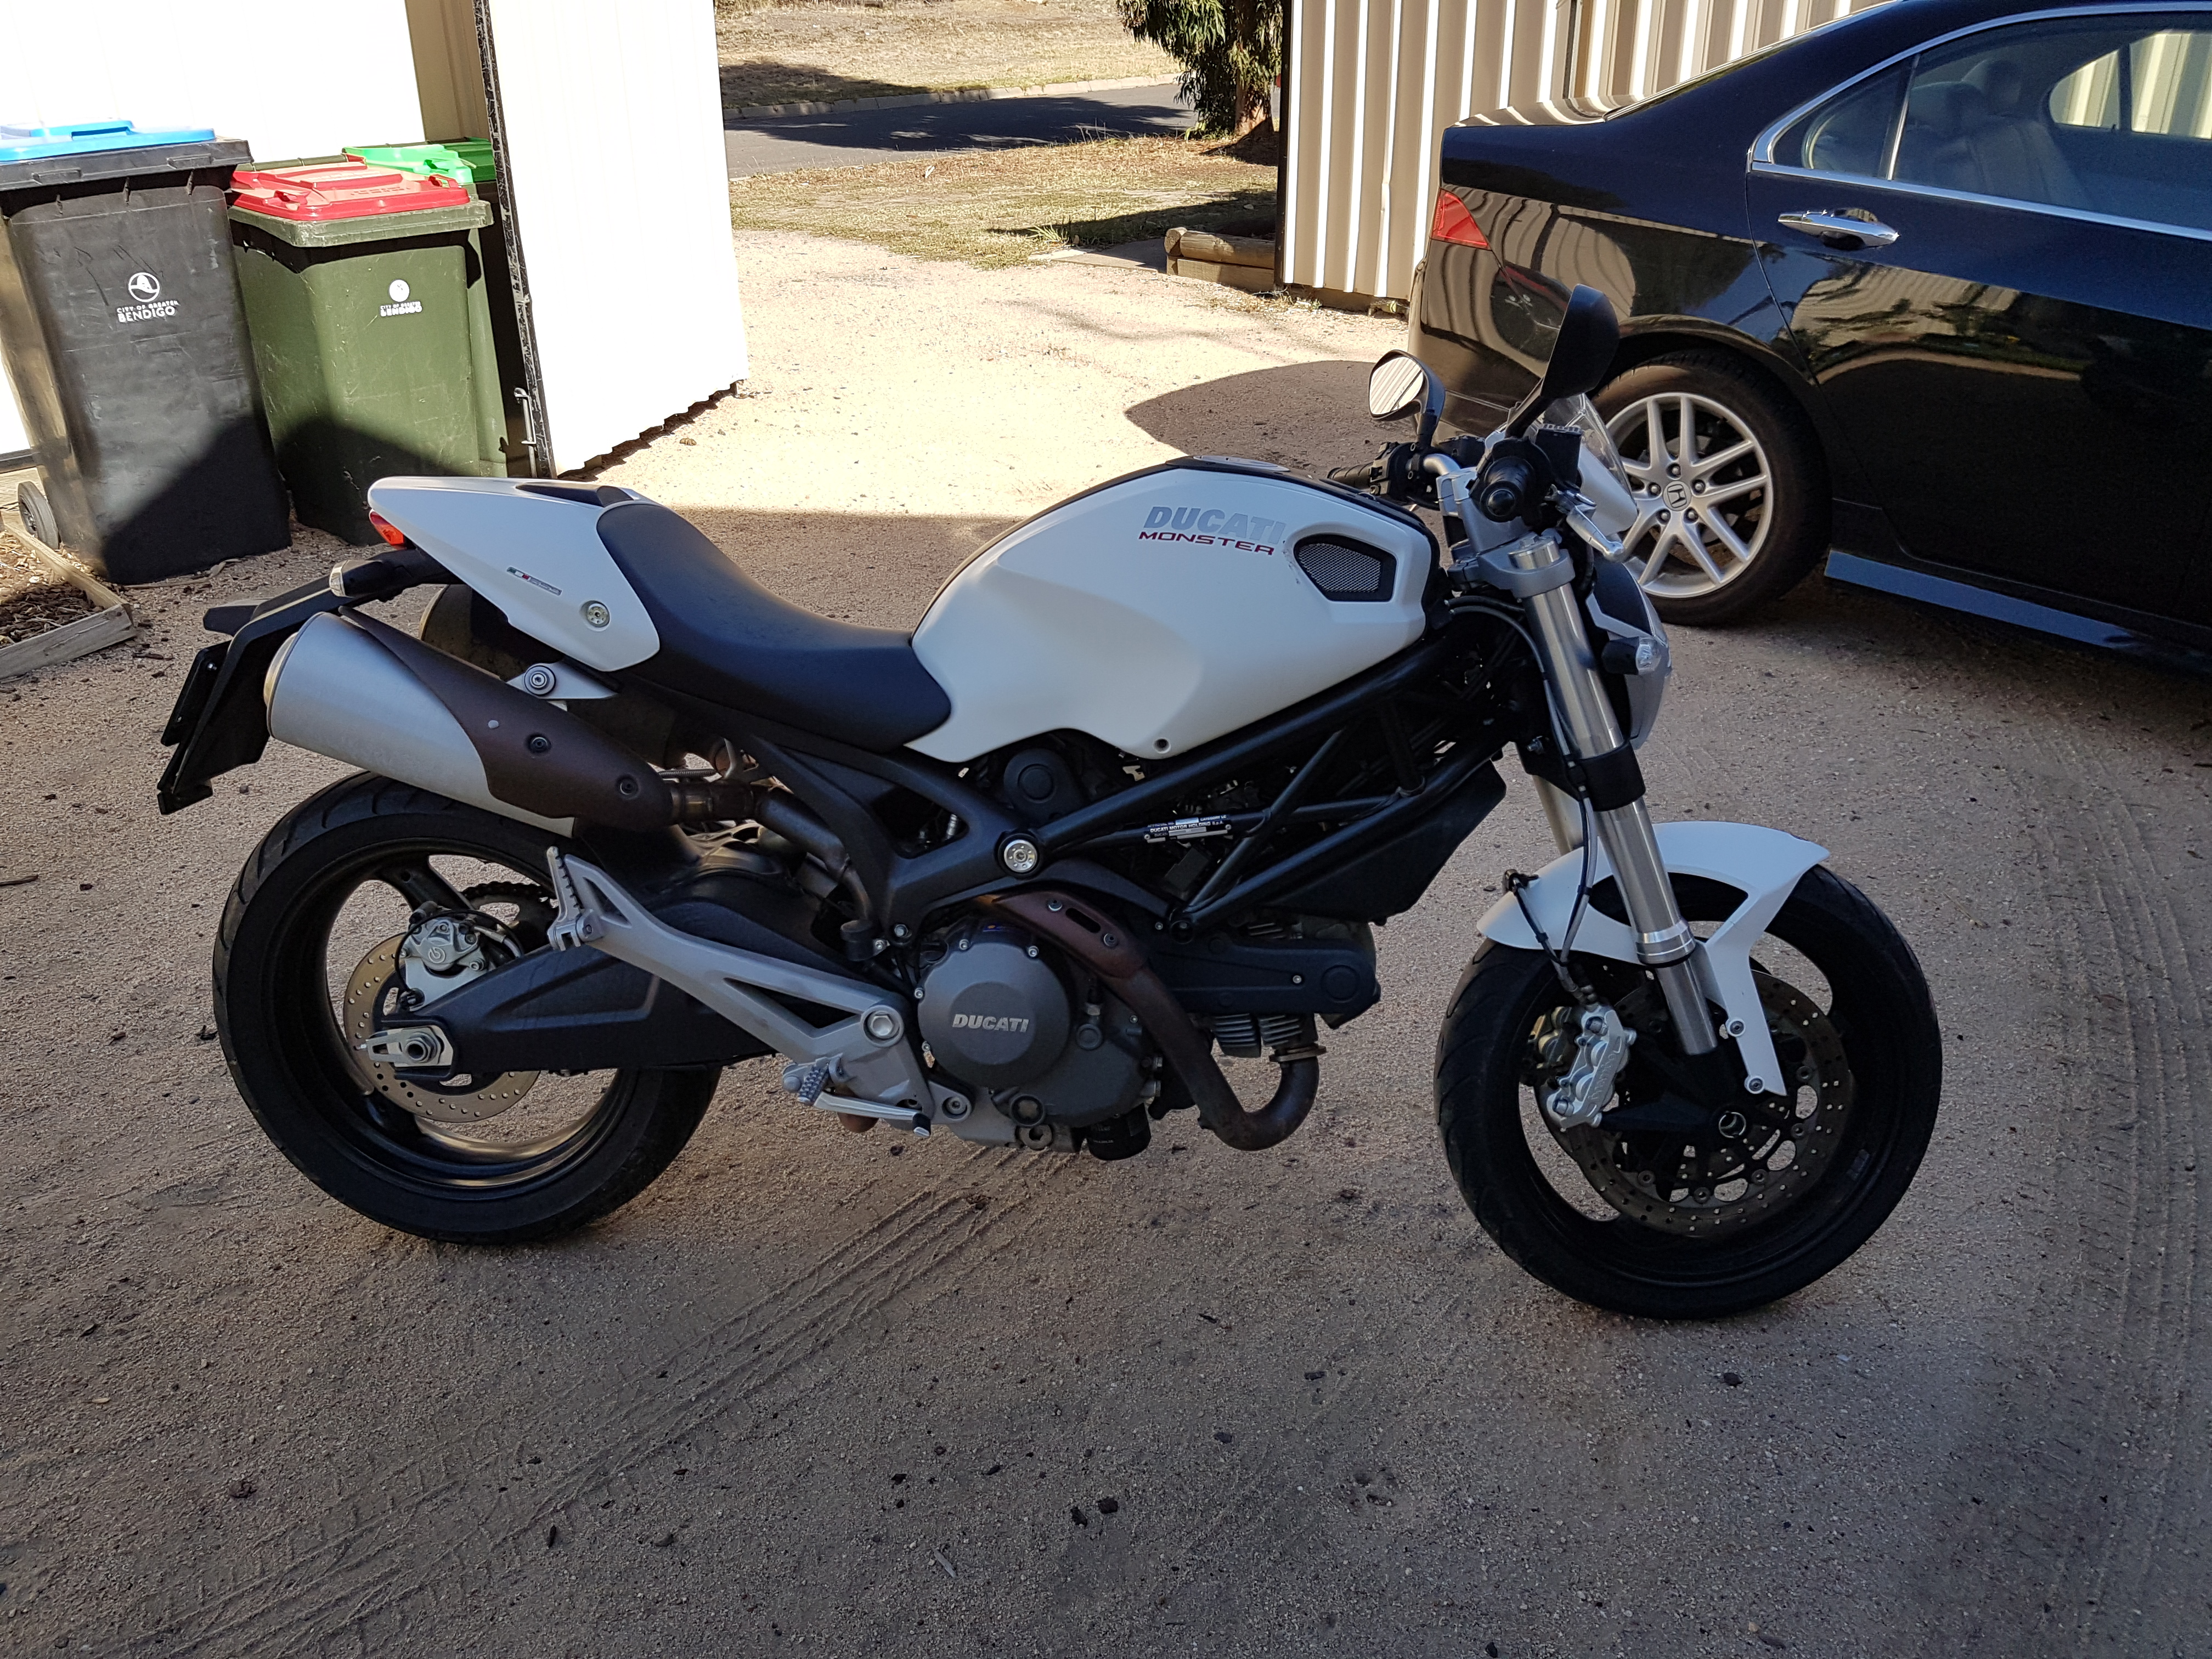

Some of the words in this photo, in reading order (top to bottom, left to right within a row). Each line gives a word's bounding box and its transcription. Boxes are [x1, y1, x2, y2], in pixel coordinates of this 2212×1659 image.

[117, 306, 176, 323] BENDIGO
[1143, 506, 1287, 545] DUCATI
[1138, 531, 1276, 556] MONSTER
[952, 1014, 1029, 1032] DUCATI
